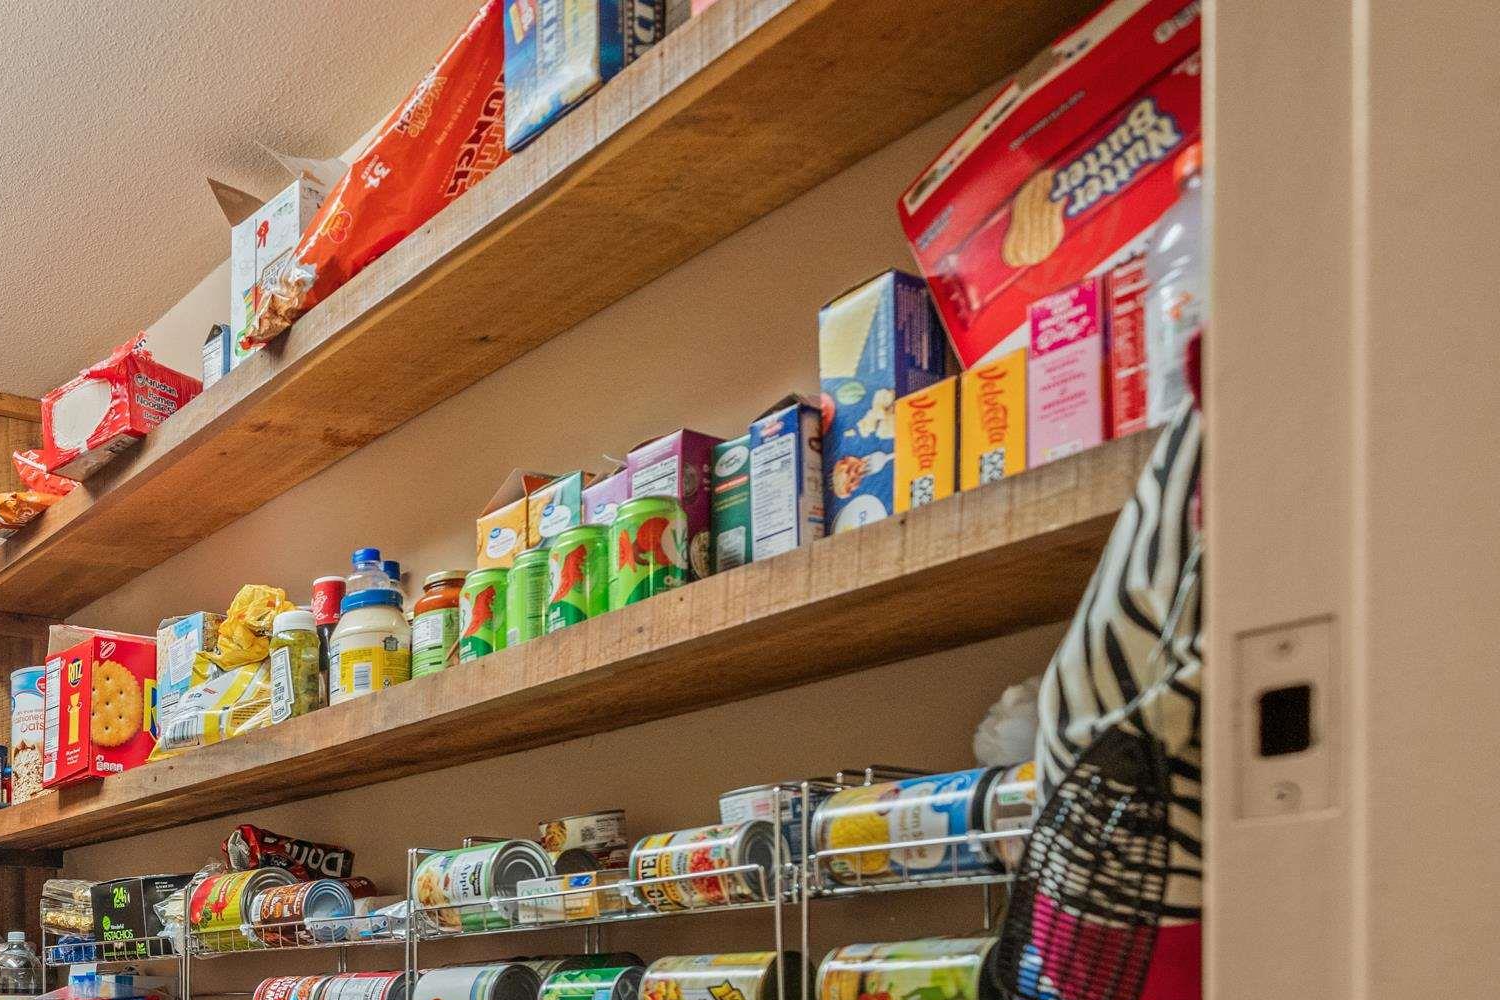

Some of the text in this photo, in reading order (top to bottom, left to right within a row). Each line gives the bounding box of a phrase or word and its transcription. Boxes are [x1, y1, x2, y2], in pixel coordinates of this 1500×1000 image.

[1049, 96, 1157, 203] Butter
[1065, 114, 1184, 219] Nutter
[908, 395, 938, 471] Velveeta
[977, 365, 1008, 445] Velveeta
[68, 660, 84, 684] RITZ
[458, 861, 469, 899] Apple
